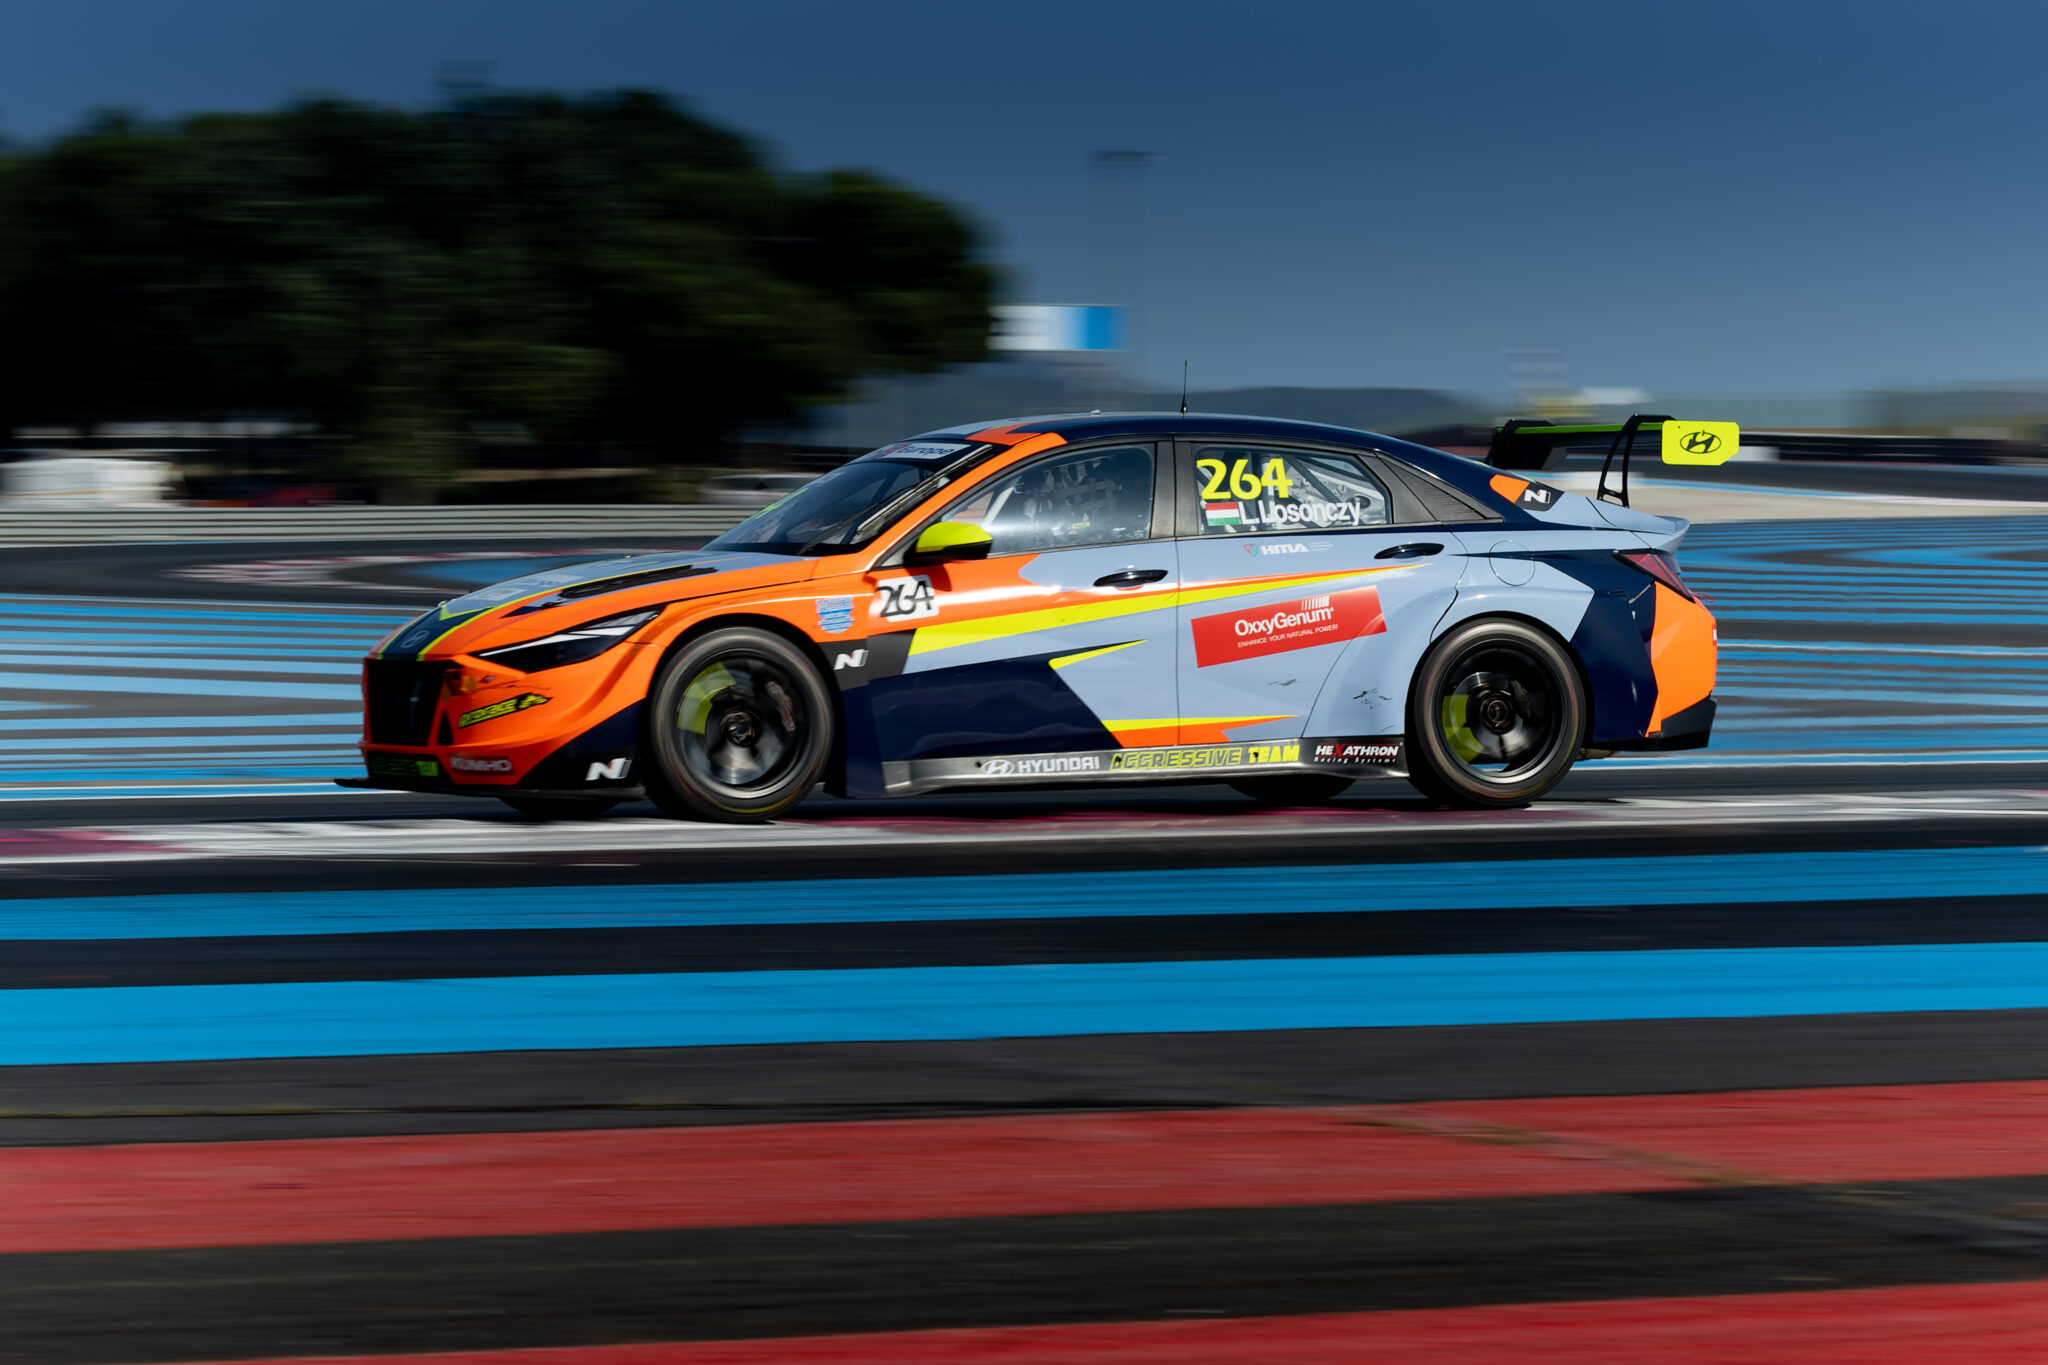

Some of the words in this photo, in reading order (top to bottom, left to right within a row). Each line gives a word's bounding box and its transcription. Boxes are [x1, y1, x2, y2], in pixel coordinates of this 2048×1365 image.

[1196, 458, 1293, 500] 264
[875, 581, 935, 617] 264
[1235, 607, 1332, 636] OxxyGenum
[1237, 638, 1267, 648] ENHANCE
[1269, 634, 1286, 642] YOUR
[1287, 629, 1314, 639] NATURAL
[1110, 748, 1242, 770] AGGRESSIVE
[1248, 745, 1301, 764] TEAM
[1315, 744, 1399, 757] HEXATHRON
[1020, 756, 1100, 773] HYUNDAI
